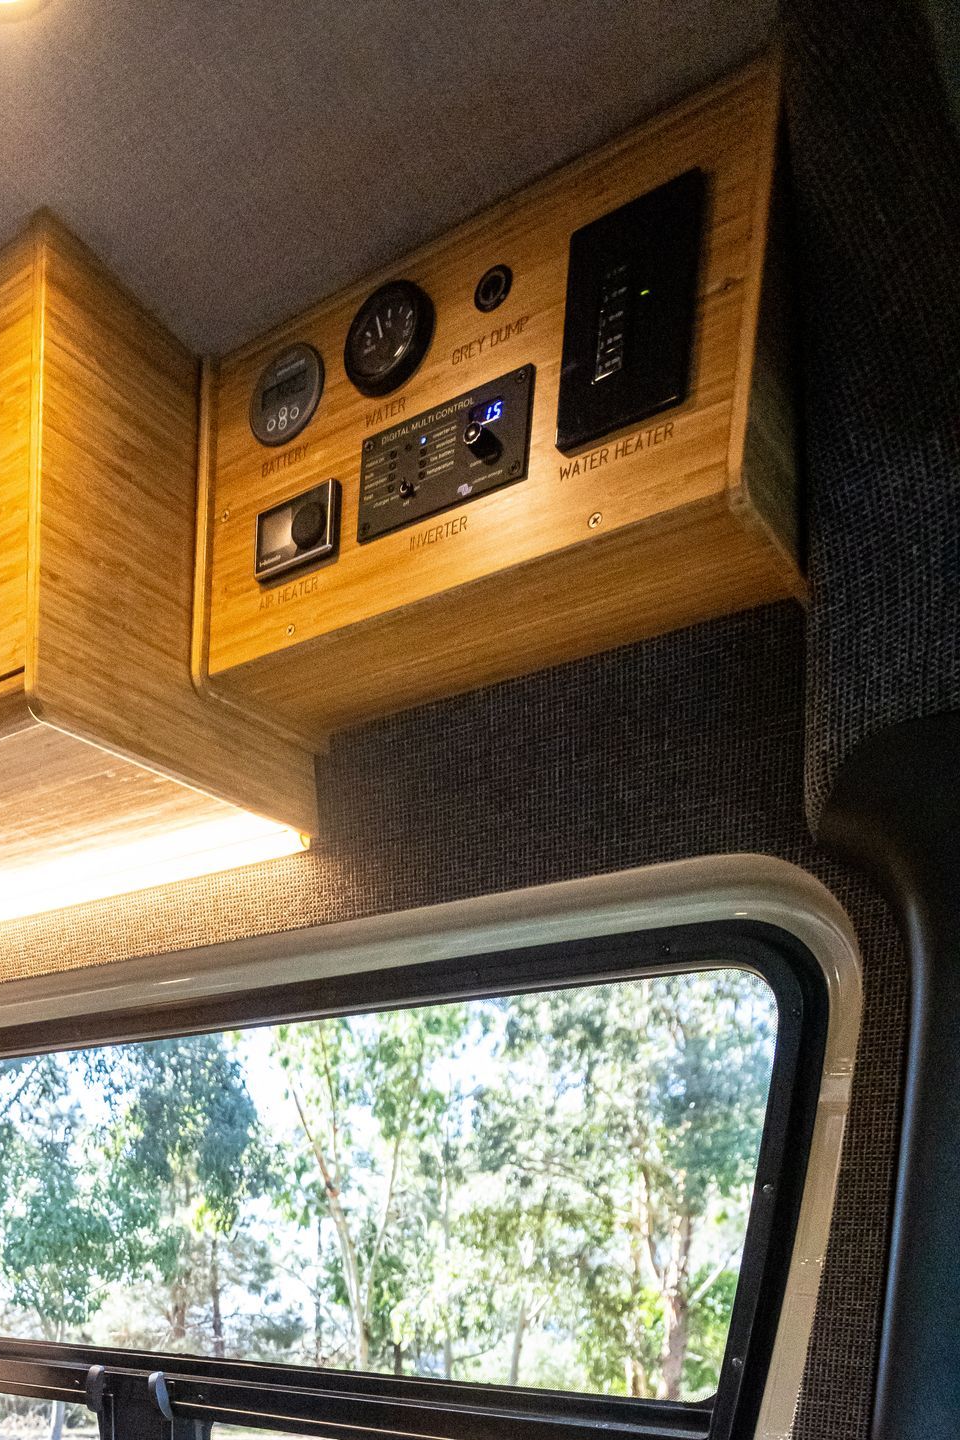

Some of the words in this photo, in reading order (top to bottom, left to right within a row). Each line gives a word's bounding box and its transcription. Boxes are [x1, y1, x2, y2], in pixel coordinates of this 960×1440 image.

[451, 335, 486, 366] GREY
[490, 315, 530, 347] DUMP
[365, 397, 406, 428] WATER
[381, 426, 409, 446] DIGITAL
[411, 417, 435, 432] MULTI
[435, 397, 474, 421] CONTROL
[485, 401, 503, 422] 15
[261, 442, 310, 479] BATTERY
[559, 447, 609, 482] WATER
[614, 421, 675, 459] HEATER
[409, 515, 468, 552] INVERTER
[259, 594, 274, 611] AIR
[277, 575, 319, 605] HEATER
